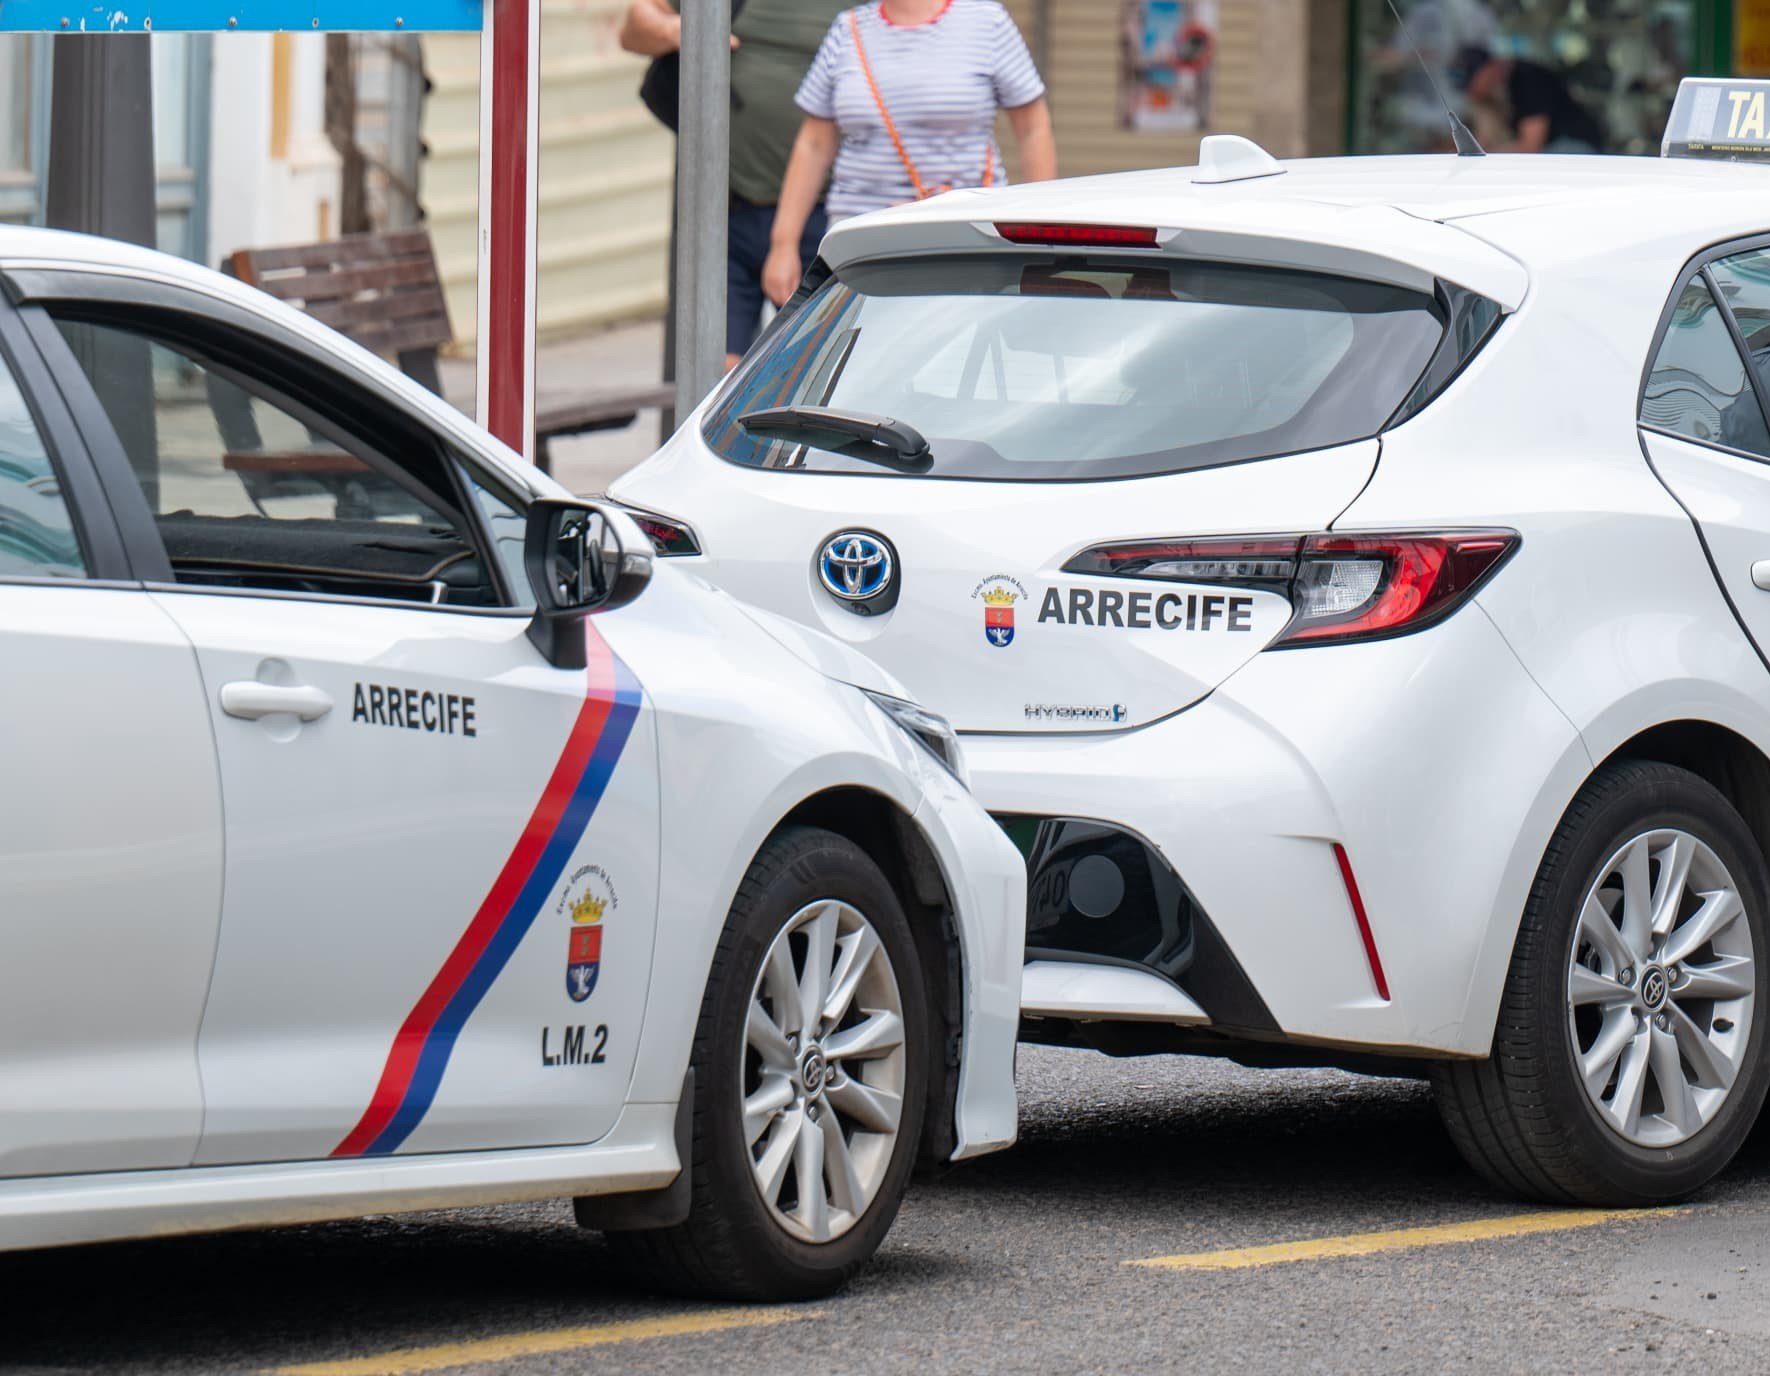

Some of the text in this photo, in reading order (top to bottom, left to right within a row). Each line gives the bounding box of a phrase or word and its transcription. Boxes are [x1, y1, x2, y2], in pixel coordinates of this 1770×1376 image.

[1036, 586, 1255, 633] ARRECIFE
[352, 682, 477, 738] ARRECIFE
[1023, 703, 1112, 722] HYBRID
[541, 1024, 609, 1067] L.M.2
